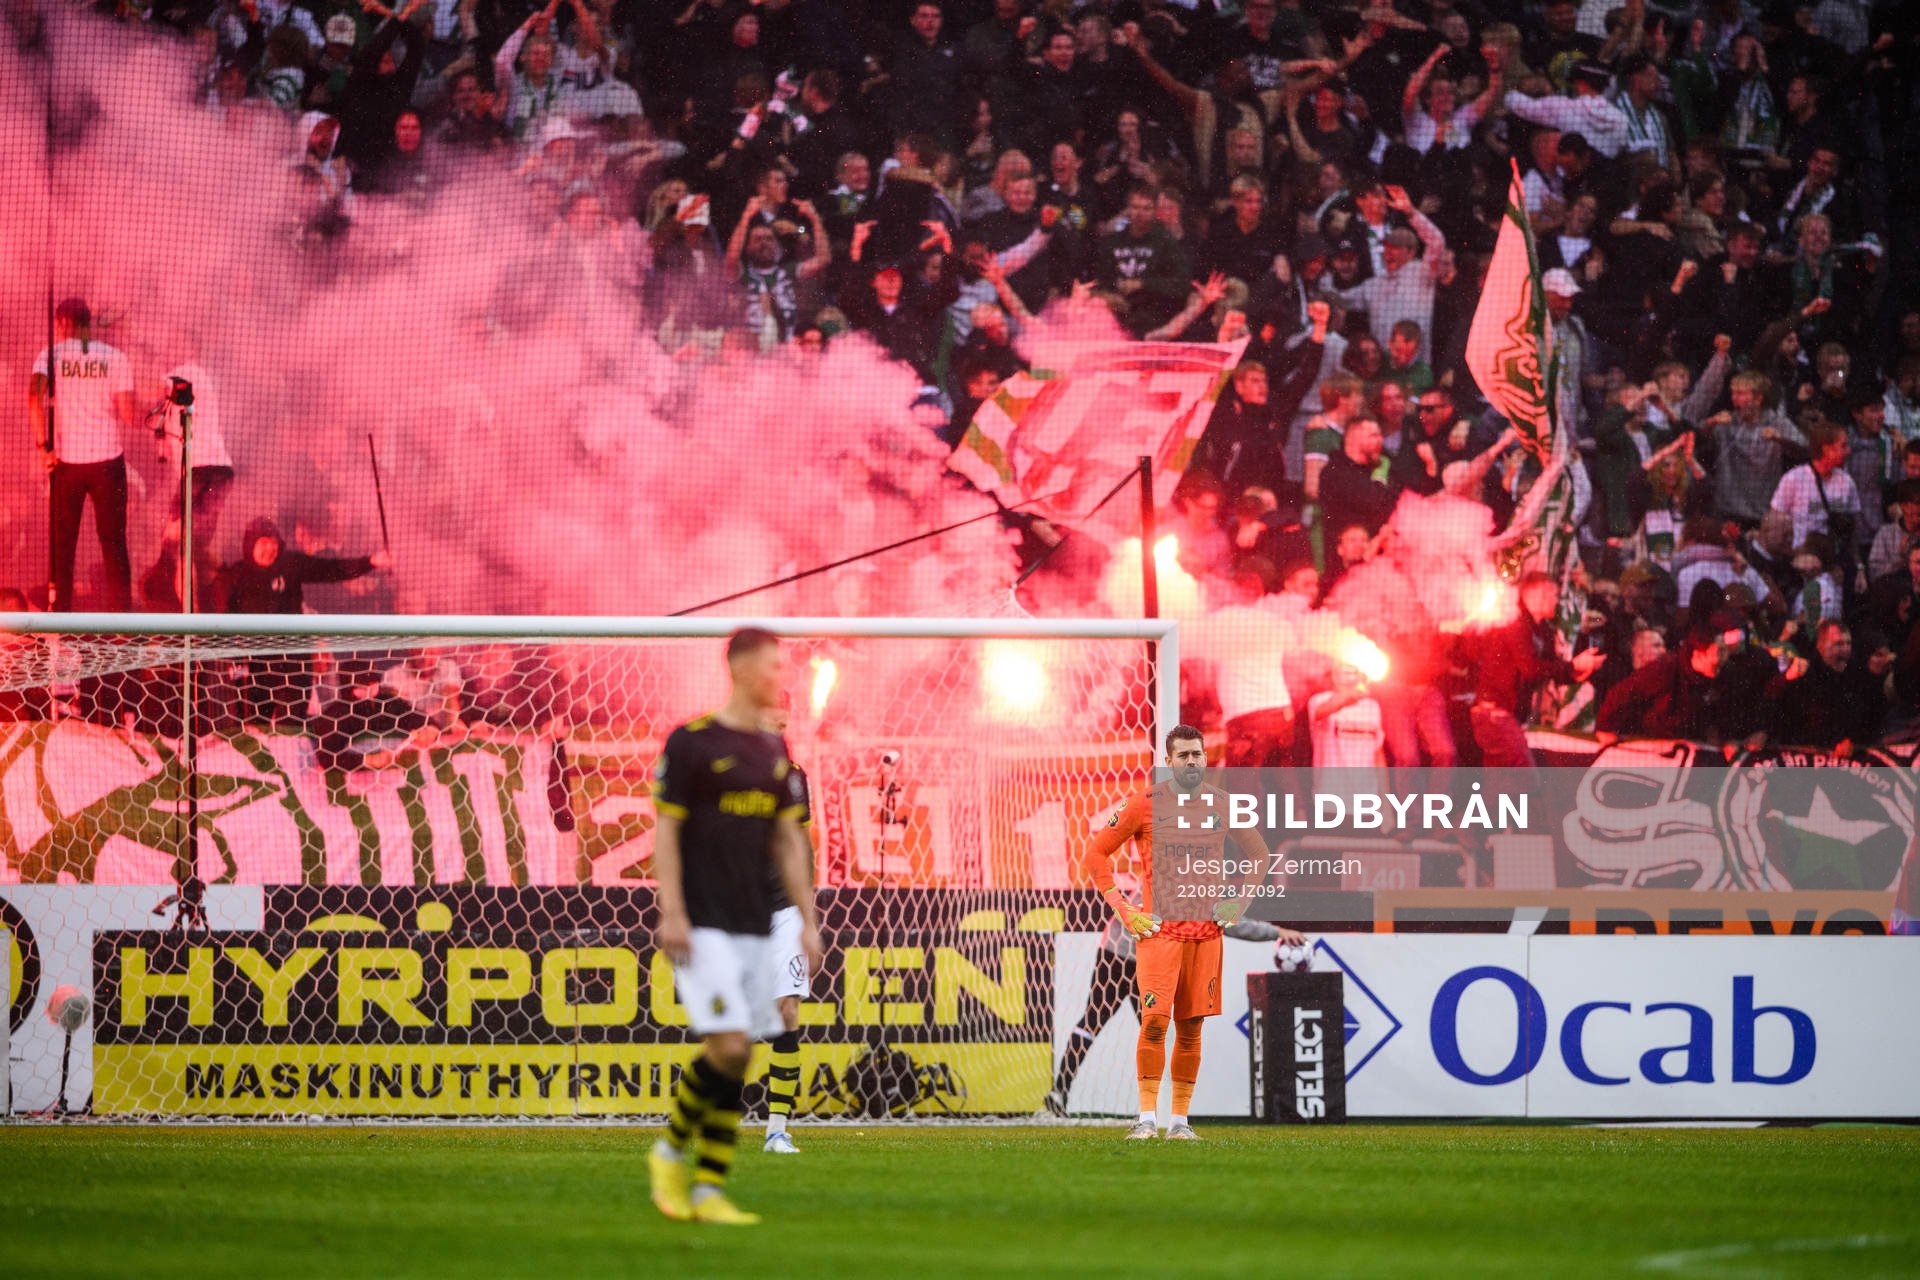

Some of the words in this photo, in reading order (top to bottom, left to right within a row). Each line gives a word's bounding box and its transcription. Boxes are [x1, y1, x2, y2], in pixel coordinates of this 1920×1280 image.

[61, 359, 109, 379] BAJEN
[1164, 842, 1213, 859] notar
[120, 946, 1026, 1027] HYRPOEN
[1429, 965, 1817, 1086] Ocab
[185, 1062, 682, 1099] MASKINUTHYRNI
[1294, 1006, 1326, 1119] SELECT
